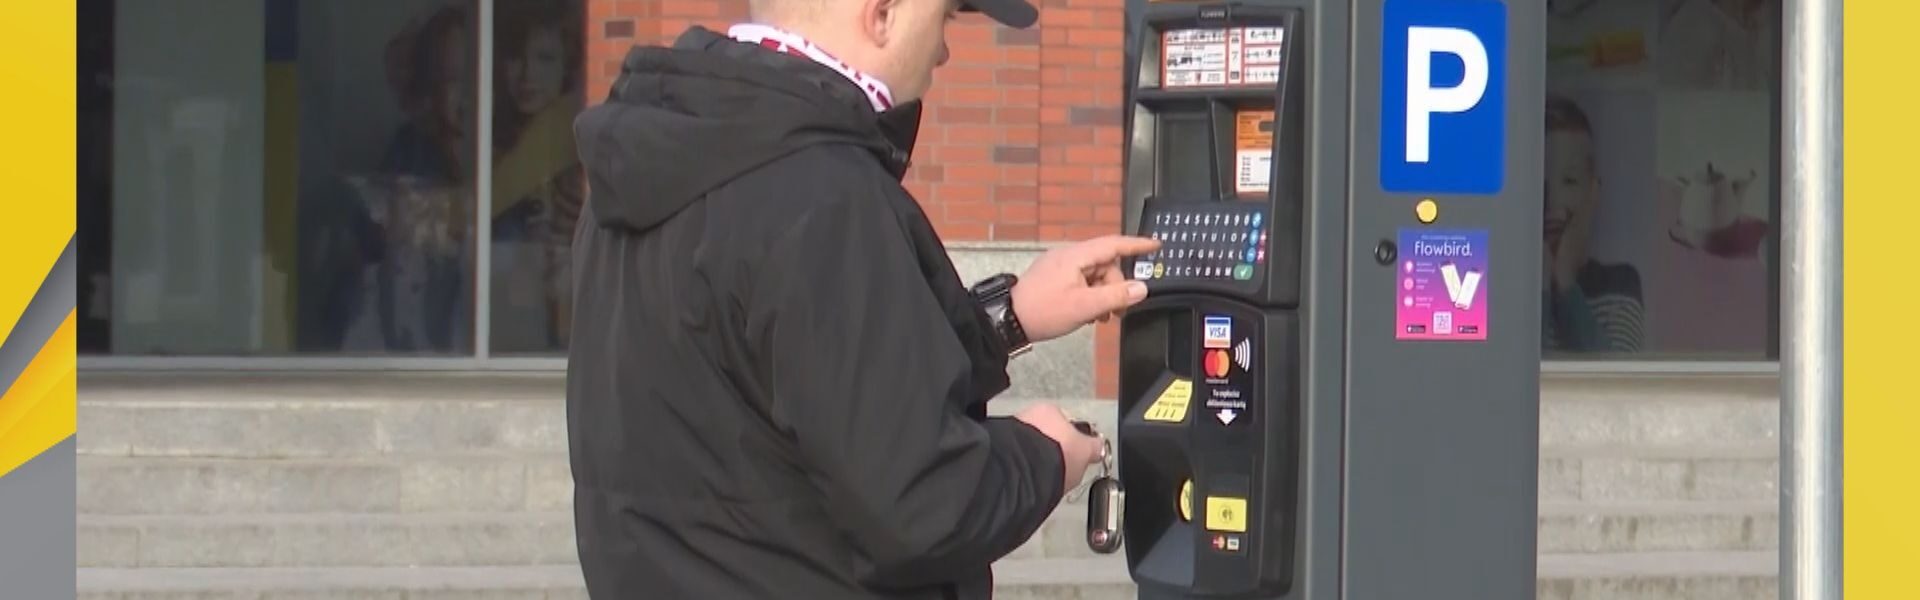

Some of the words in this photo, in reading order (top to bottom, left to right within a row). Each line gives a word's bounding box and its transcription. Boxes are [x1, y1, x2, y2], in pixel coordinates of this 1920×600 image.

[1405, 26, 1489, 163] P
[1414, 240, 1473, 257] flowbird.
[1209, 326, 1226, 338] VISA
